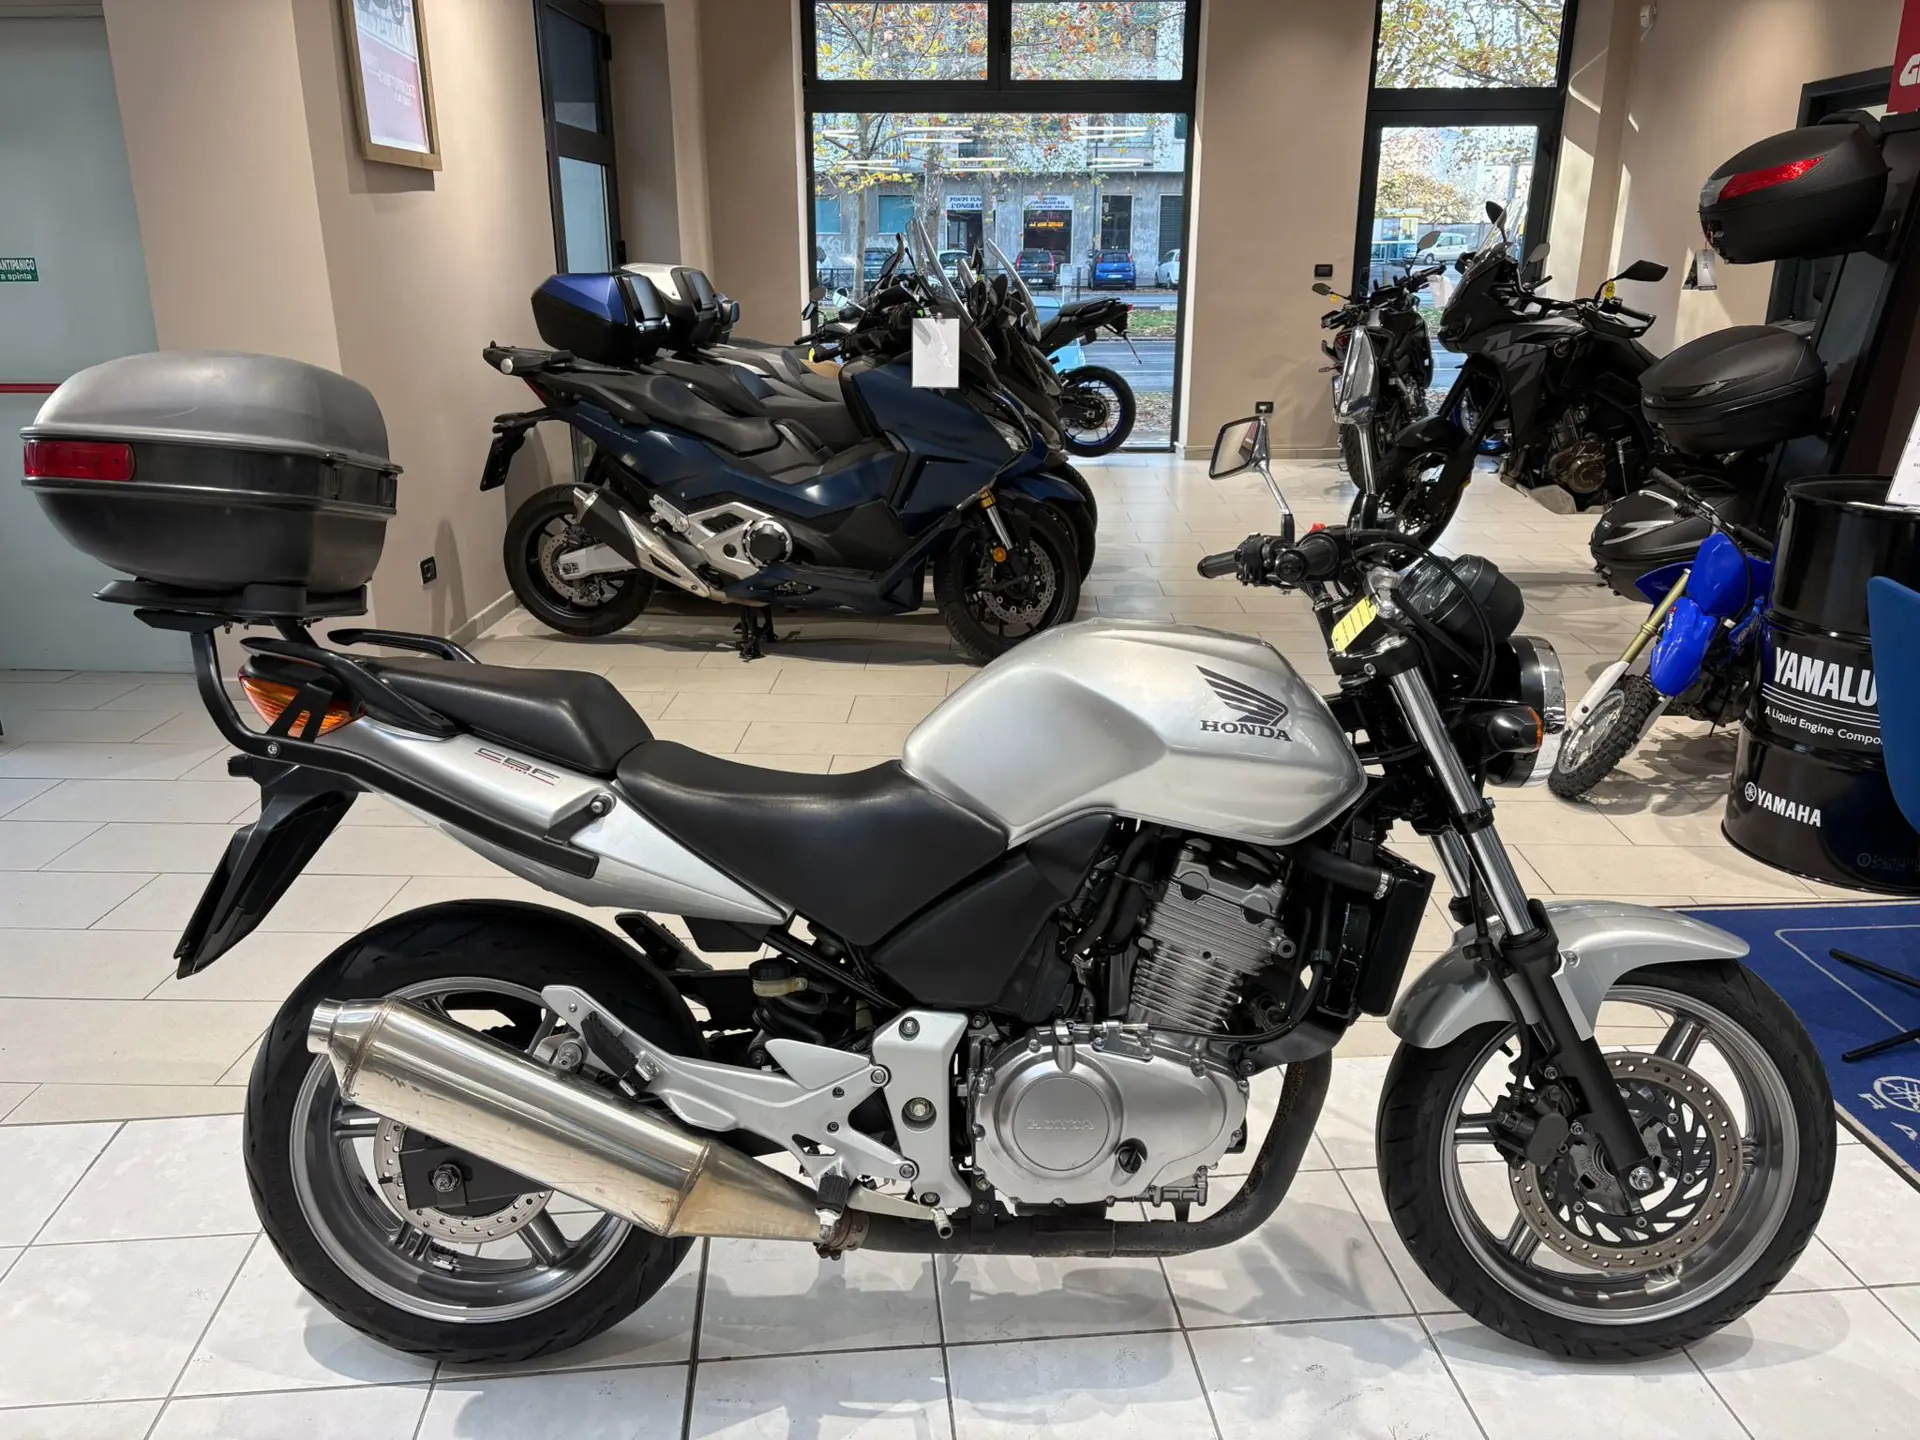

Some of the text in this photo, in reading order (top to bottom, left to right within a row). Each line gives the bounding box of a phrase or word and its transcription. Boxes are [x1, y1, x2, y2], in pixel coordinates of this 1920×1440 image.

[7, 271, 32, 281] spinta
[1774, 646, 1878, 706] YAMALU
[1200, 720, 1293, 742] HONDA
[1764, 705, 1883, 746] A Liquid Engine Compo
[478, 747, 560, 779] CBF
[1757, 787, 1822, 828] YAMAHA
